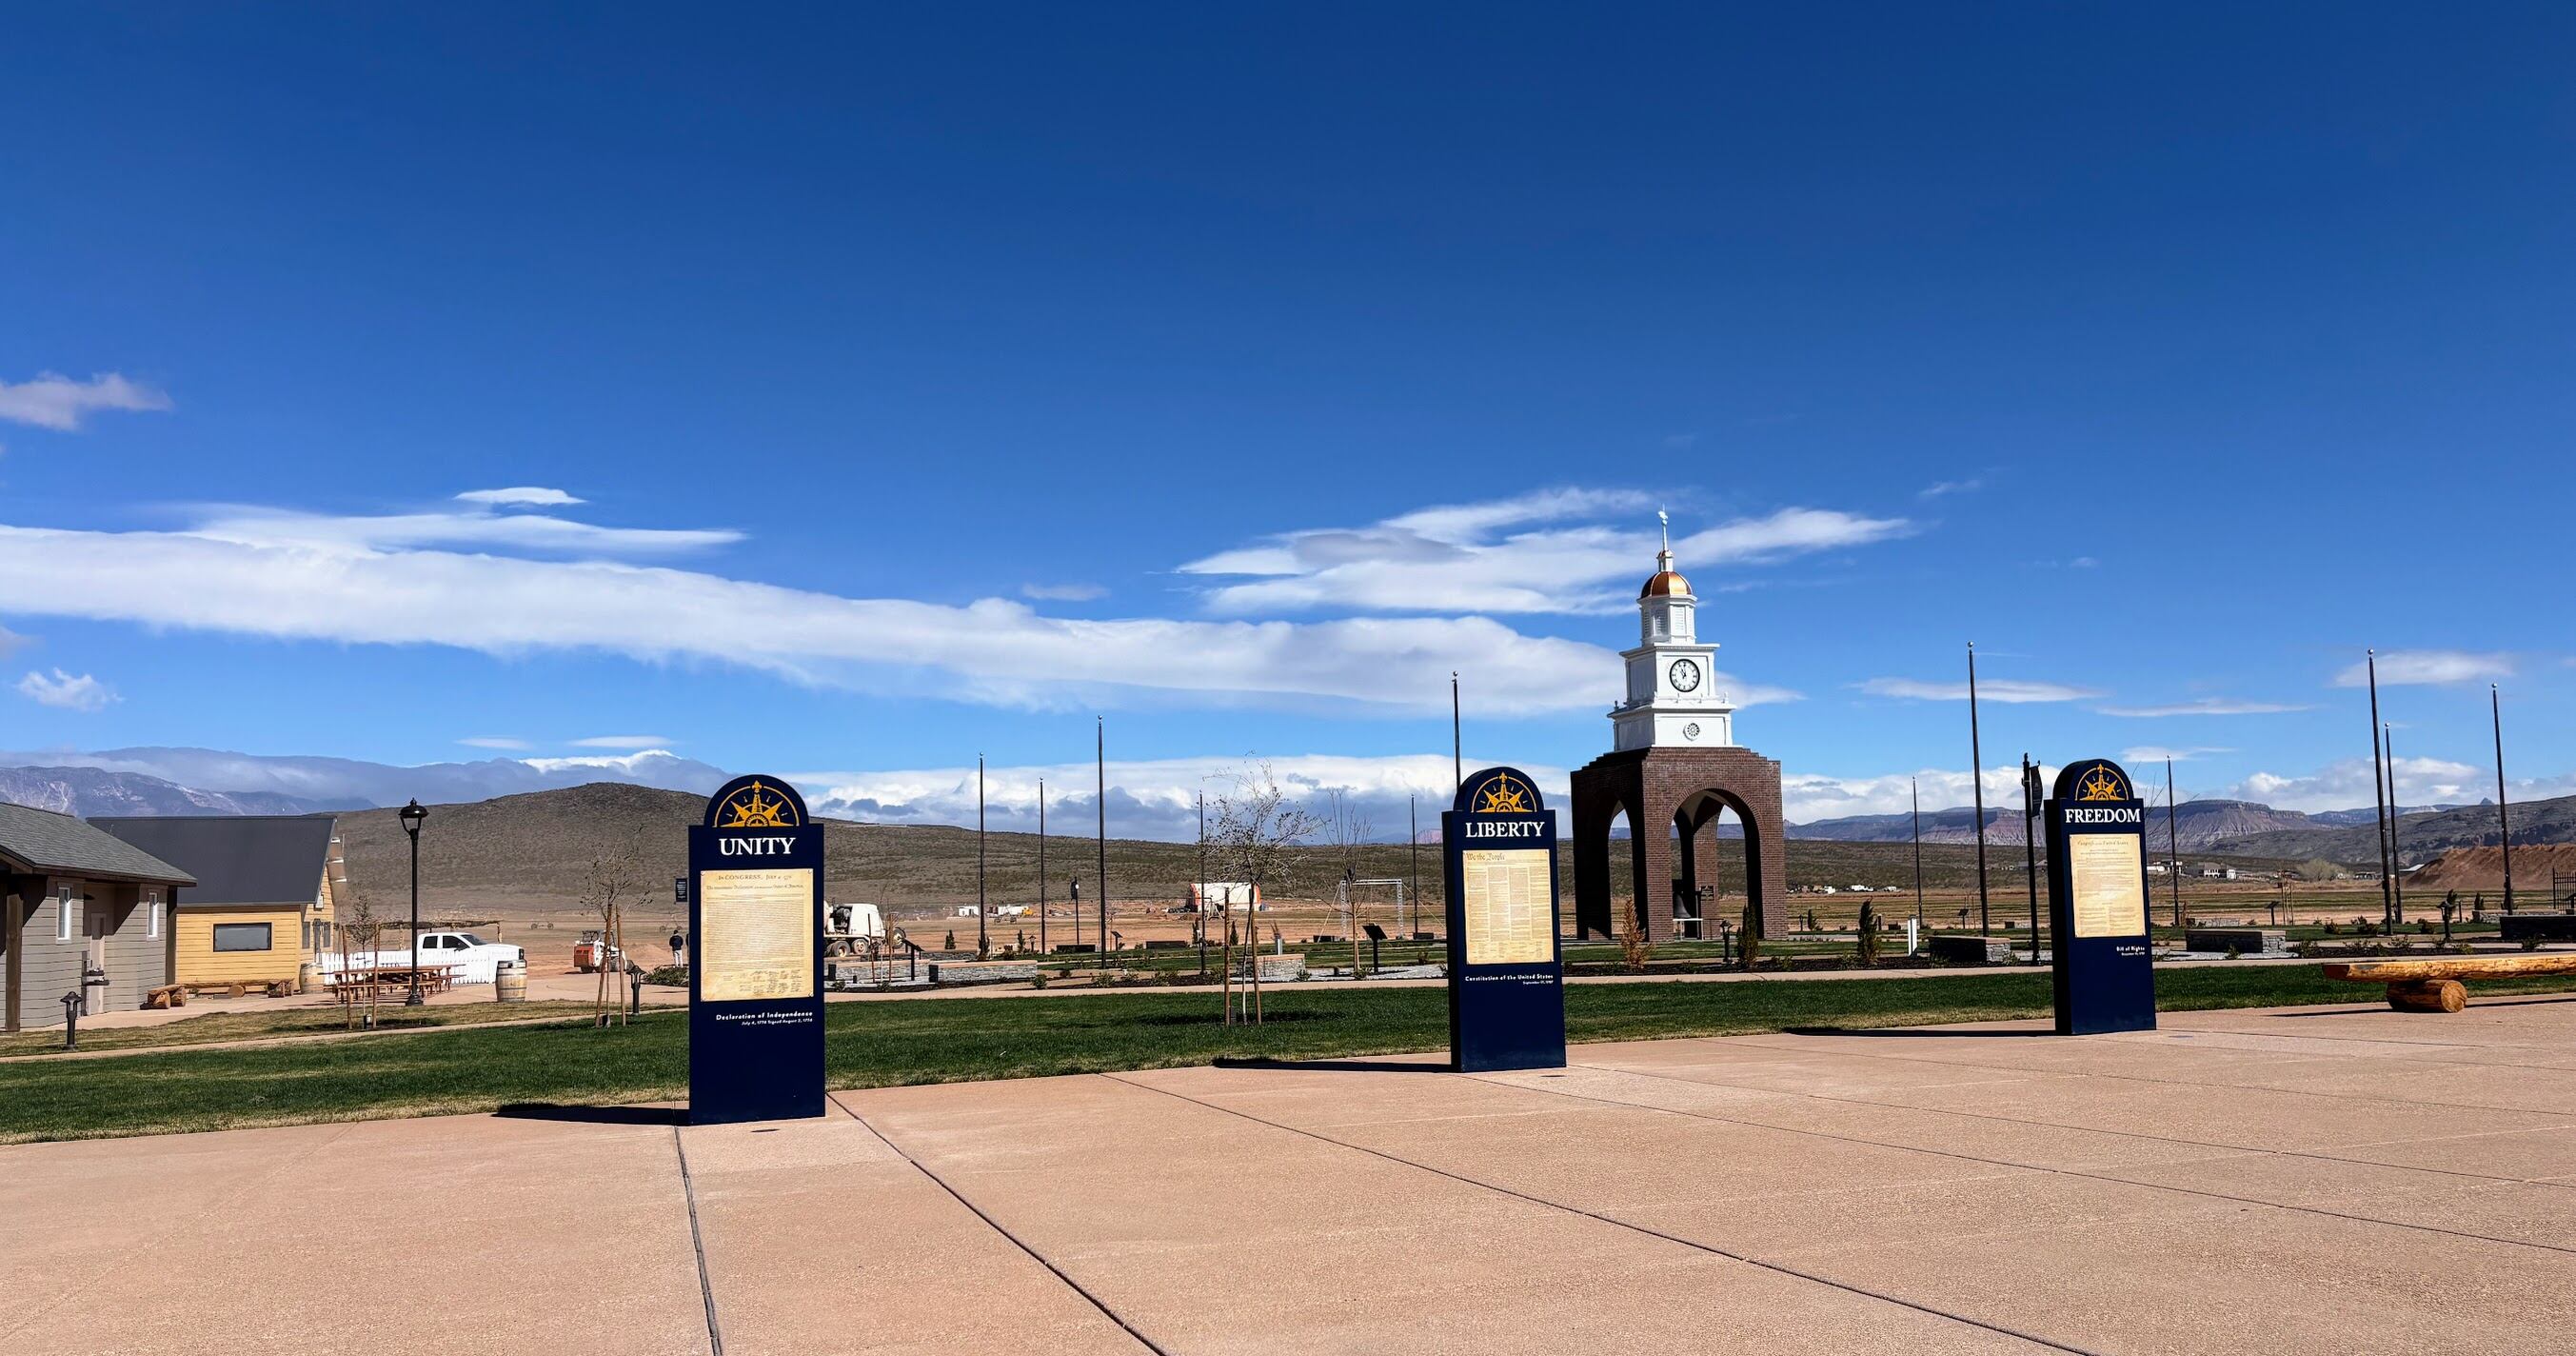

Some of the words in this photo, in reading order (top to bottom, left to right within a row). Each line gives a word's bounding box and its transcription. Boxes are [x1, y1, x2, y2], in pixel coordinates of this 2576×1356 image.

[2065, 808, 2141, 823] FREEDOM
[1466, 822, 1545, 838] LIBERTY
[719, 837, 796, 855] UNITY
[716, 1012, 756, 1021] Declaration
[766, 1010, 813, 1019] Independence
